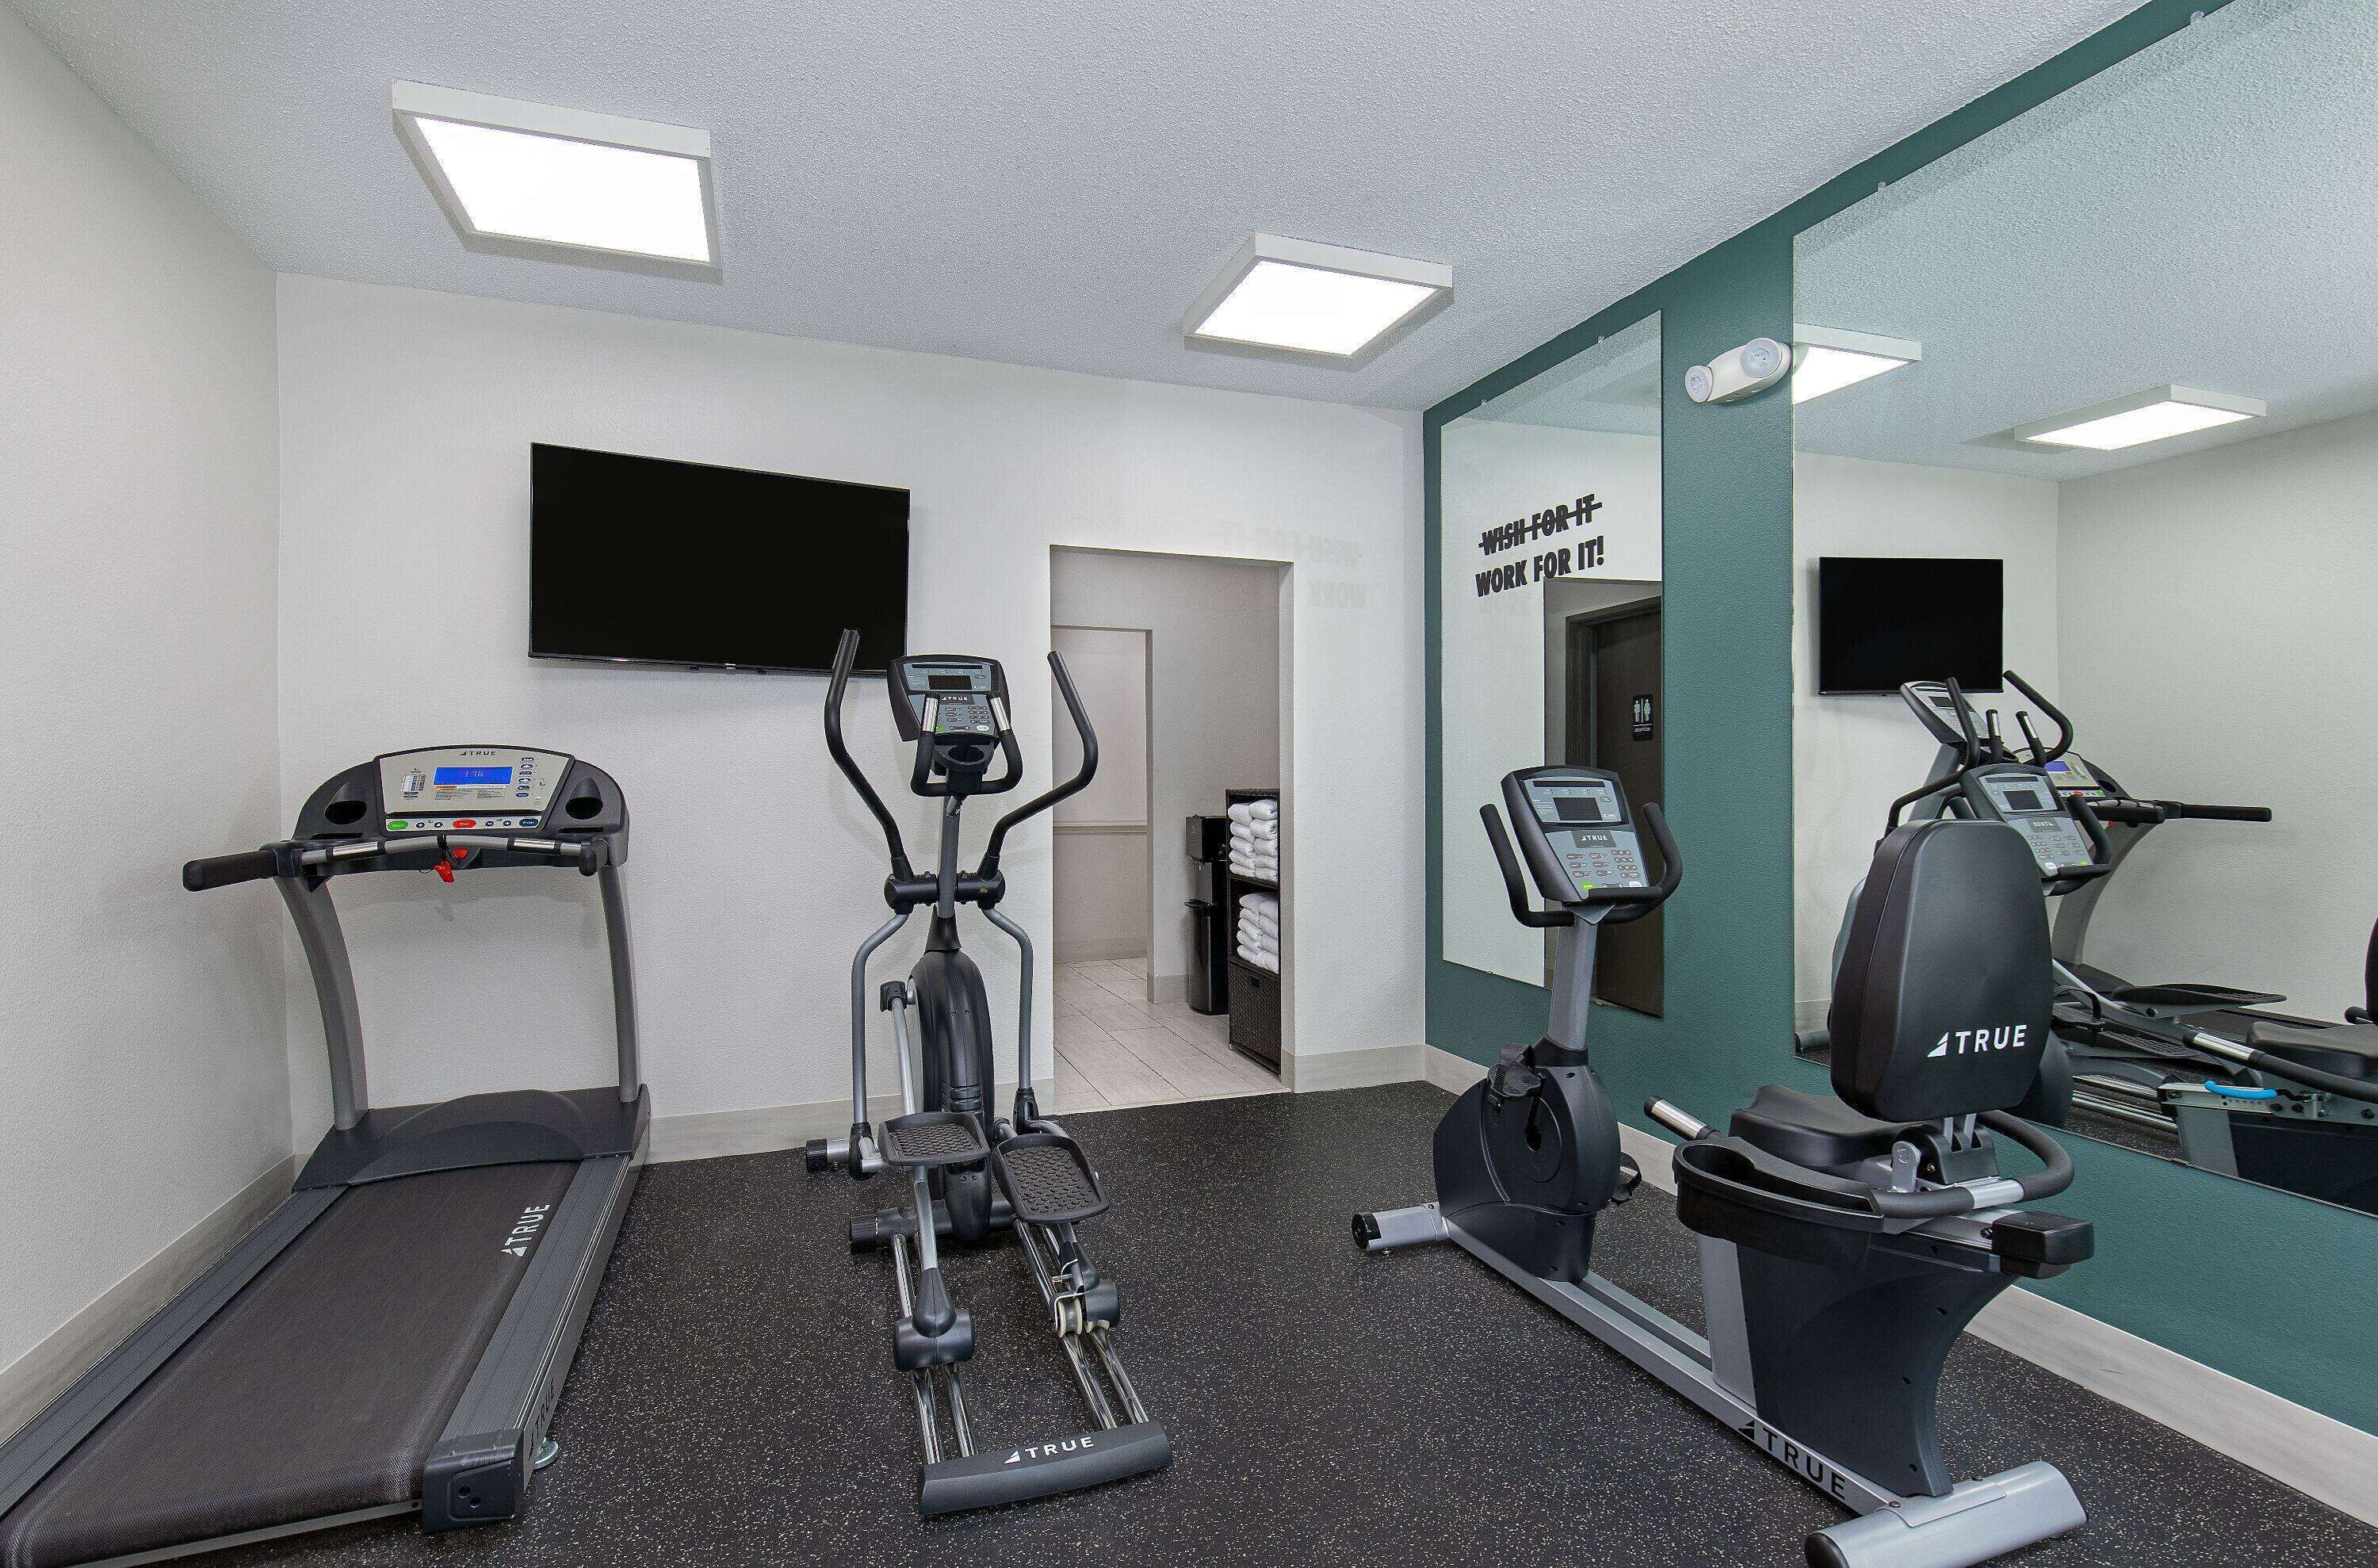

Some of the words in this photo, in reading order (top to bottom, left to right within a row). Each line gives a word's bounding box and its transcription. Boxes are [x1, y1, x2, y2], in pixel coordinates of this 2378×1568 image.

[1482, 518, 1525, 556] WISH
[1531, 504, 1569, 541] FOR
[1576, 493, 1595, 526] IT
[1475, 560, 1528, 597] WORK
[1534, 548, 1572, 583] FOR
[1577, 535, 1604, 571] IT!
[1955, 1024, 2027, 1054] TRUE
[505, 1204, 551, 1246] TRUE
[1025, 1436, 1095, 1459] TRUE
[1762, 1426, 1845, 1501] TRUE
